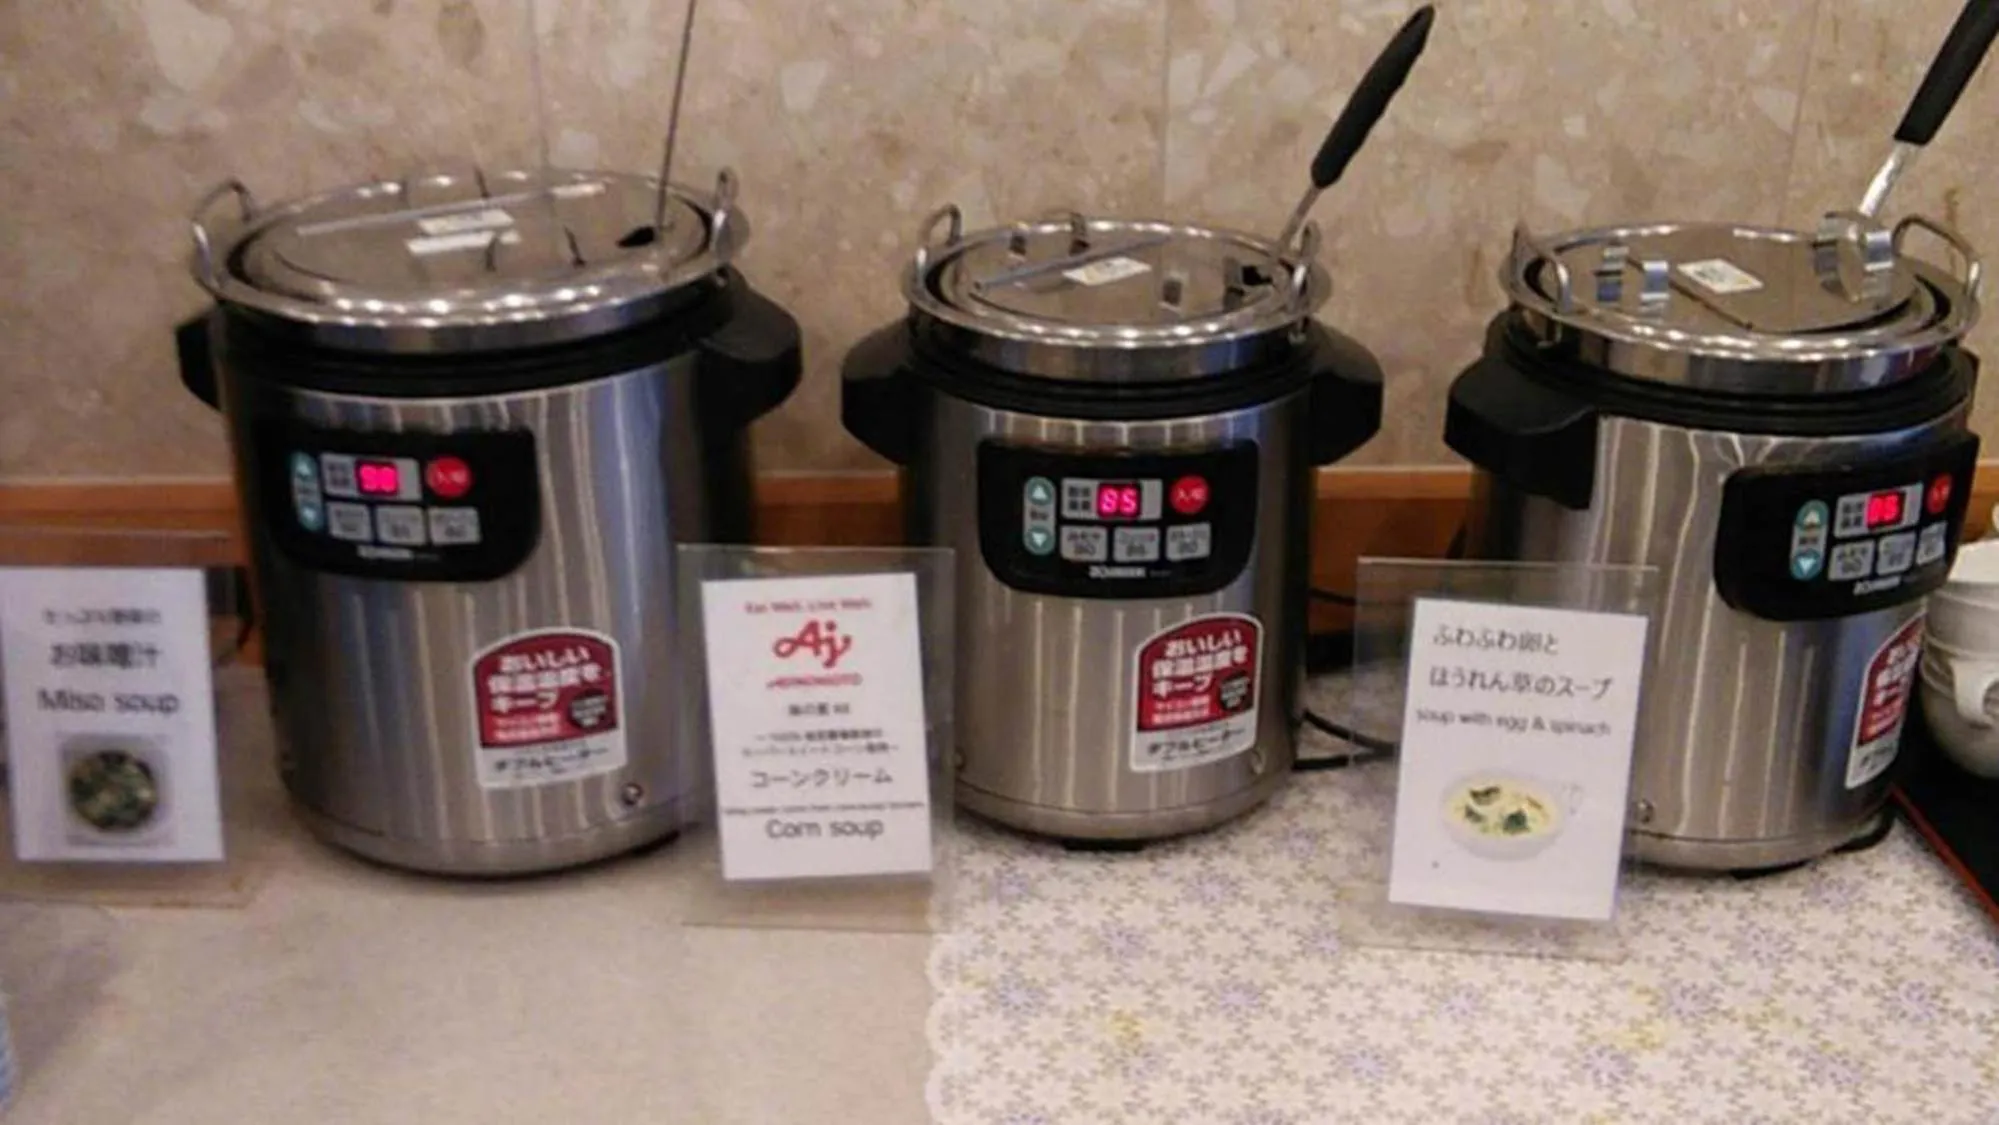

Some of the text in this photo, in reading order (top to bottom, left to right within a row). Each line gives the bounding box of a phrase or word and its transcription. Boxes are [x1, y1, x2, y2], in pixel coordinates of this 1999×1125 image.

[1432, 624, 1560, 656] ふわふわ卵と
[1428, 664, 1614, 701] ほうれん草のスープ
[750, 767, 893, 789] コーンクリーム
[765, 808, 822, 839] Corn
[829, 809, 884, 841] soup
